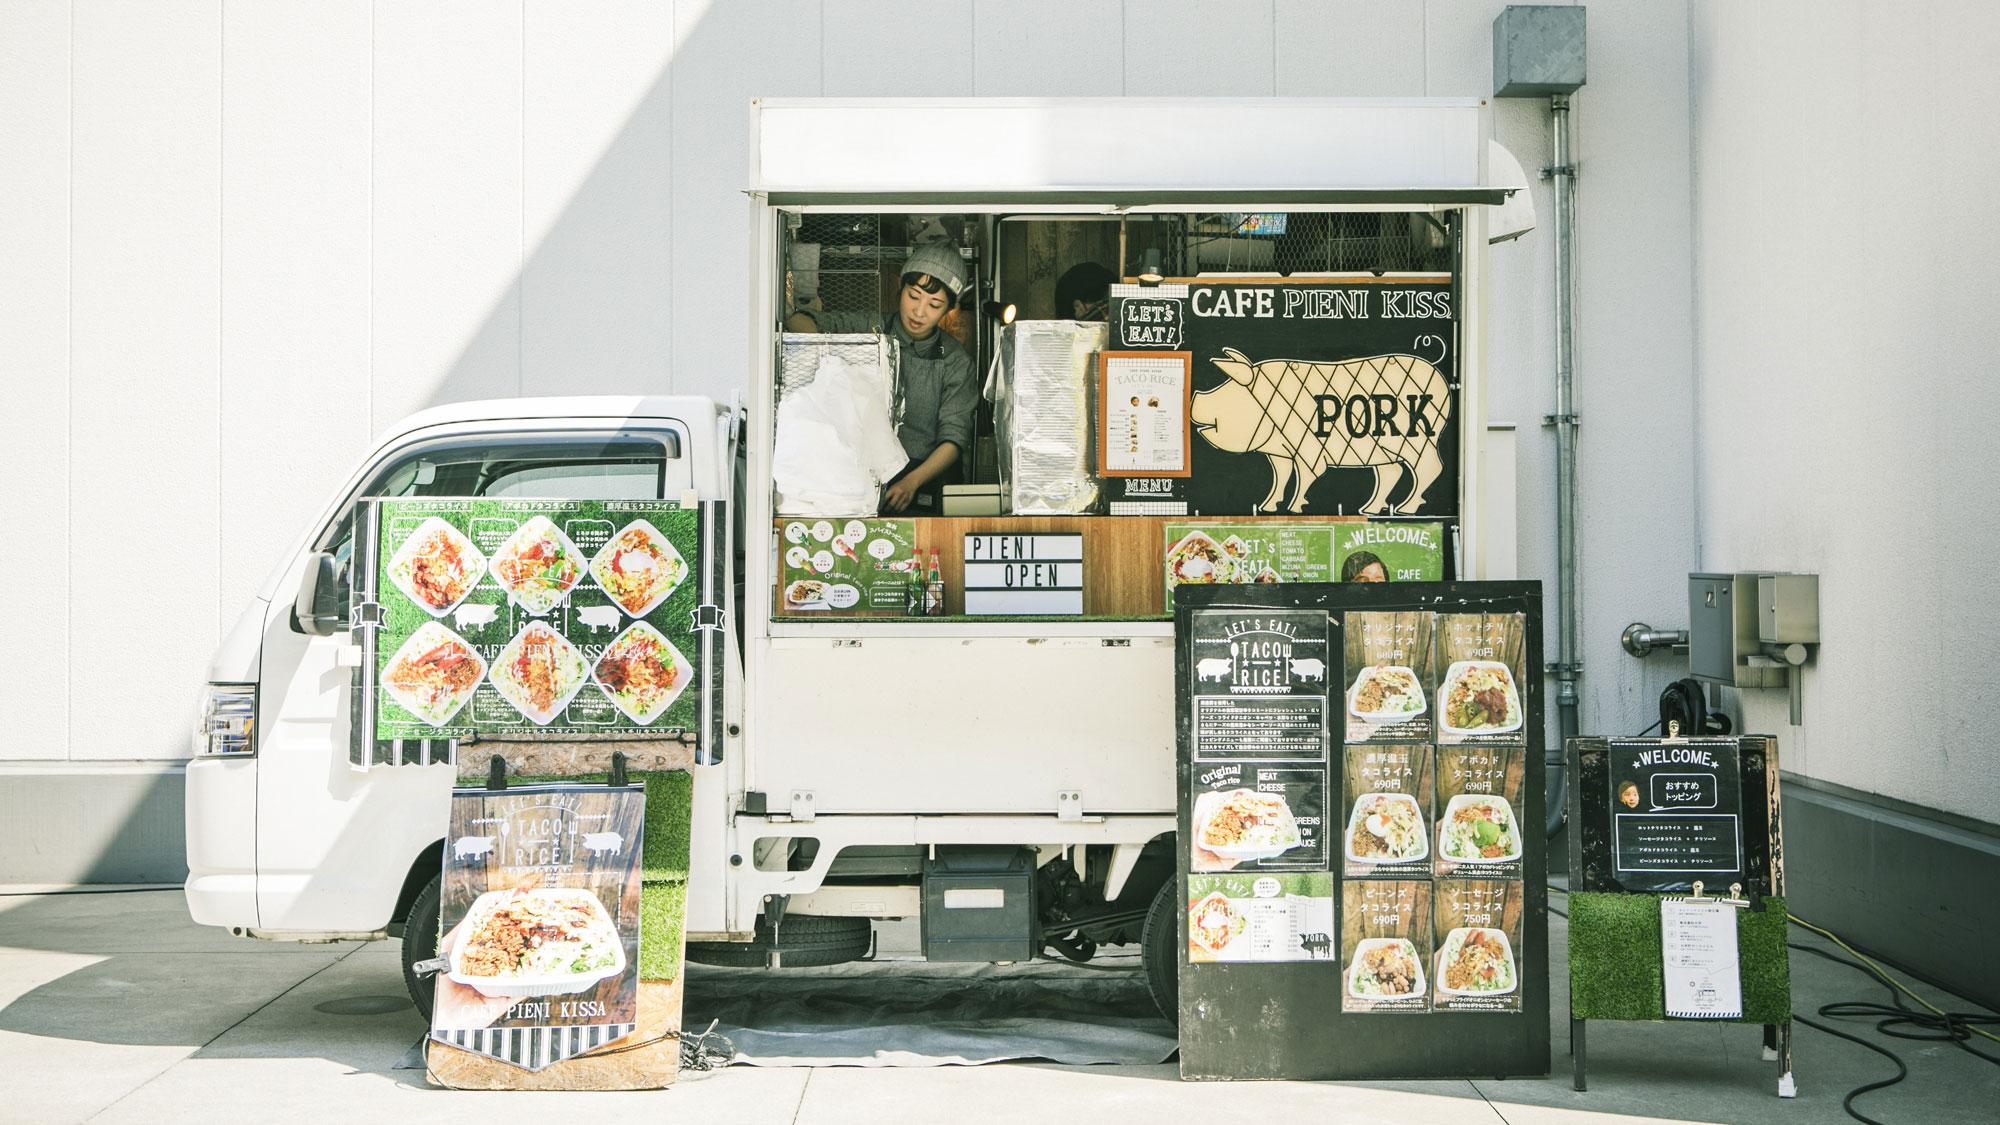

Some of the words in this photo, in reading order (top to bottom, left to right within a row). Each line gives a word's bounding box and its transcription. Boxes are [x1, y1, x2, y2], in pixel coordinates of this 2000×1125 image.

[1192, 288, 1275, 318] CAFE
[1283, 289, 1369, 319] PIENI
[1381, 290, 1452, 319] KISS
[1128, 326, 1176, 343] EAT!
[1116, 374, 1147, 385] TACO
[1151, 374, 1177, 386] RICE
[1314, 394, 1436, 439] PORK
[1125, 478, 1173, 492] MENU
[1351, 528, 1431, 548] WELCOME
[973, 537, 1035, 560] PIENI
[1005, 563, 1058, 587] OPEN
[1397, 569, 1421, 580] CAFE
[1225, 619, 1261, 637] LET'S
[1269, 619, 1297, 637] EAT!
[1363, 623, 1415, 632] オリジナル
[1454, 623, 1504, 632] ホットチリ
[1364, 637, 1415, 646] タコライス
[1455, 636, 1505, 645] タコライス
[1241, 642, 1281, 658] TACO
[1241, 669, 1281, 686] RICE
[1459, 755, 1499, 765] アボカド
[1639, 749, 1712, 766] WELCOME
[1200, 764, 1242, 784] Original
[1362, 767, 1413, 776] タコライス
[1454, 770, 1504, 779] タコライス
[1211, 779, 1227, 789] Taco
[1227, 777, 1240, 785] rice
[1260, 783, 1286, 792] CHEESE
[1374, 779, 1401, 789] 690円
[1465, 781, 1492, 791] 690円
[1665, 781, 1700, 790] おすすめ
[1665, 792, 1701, 801] トッピング
[1294, 816, 1320, 825] GREENS
[518, 819, 563, 836] TACO
[515, 848, 561, 866] RICE
[1366, 888, 1407, 898] ビーンズ
[1452, 888, 1504, 898] ソーセージ
[1361, 903, 1412, 913] タコライス
[1452, 902, 1503, 911] タコライス
[1373, 915, 1400, 925] 690円
[1464, 914, 1491, 924] 750円
[1306, 933, 1325, 942] PORK
[506, 1002, 550, 1019] PIENI
[560, 1000, 606, 1018] KISSA
